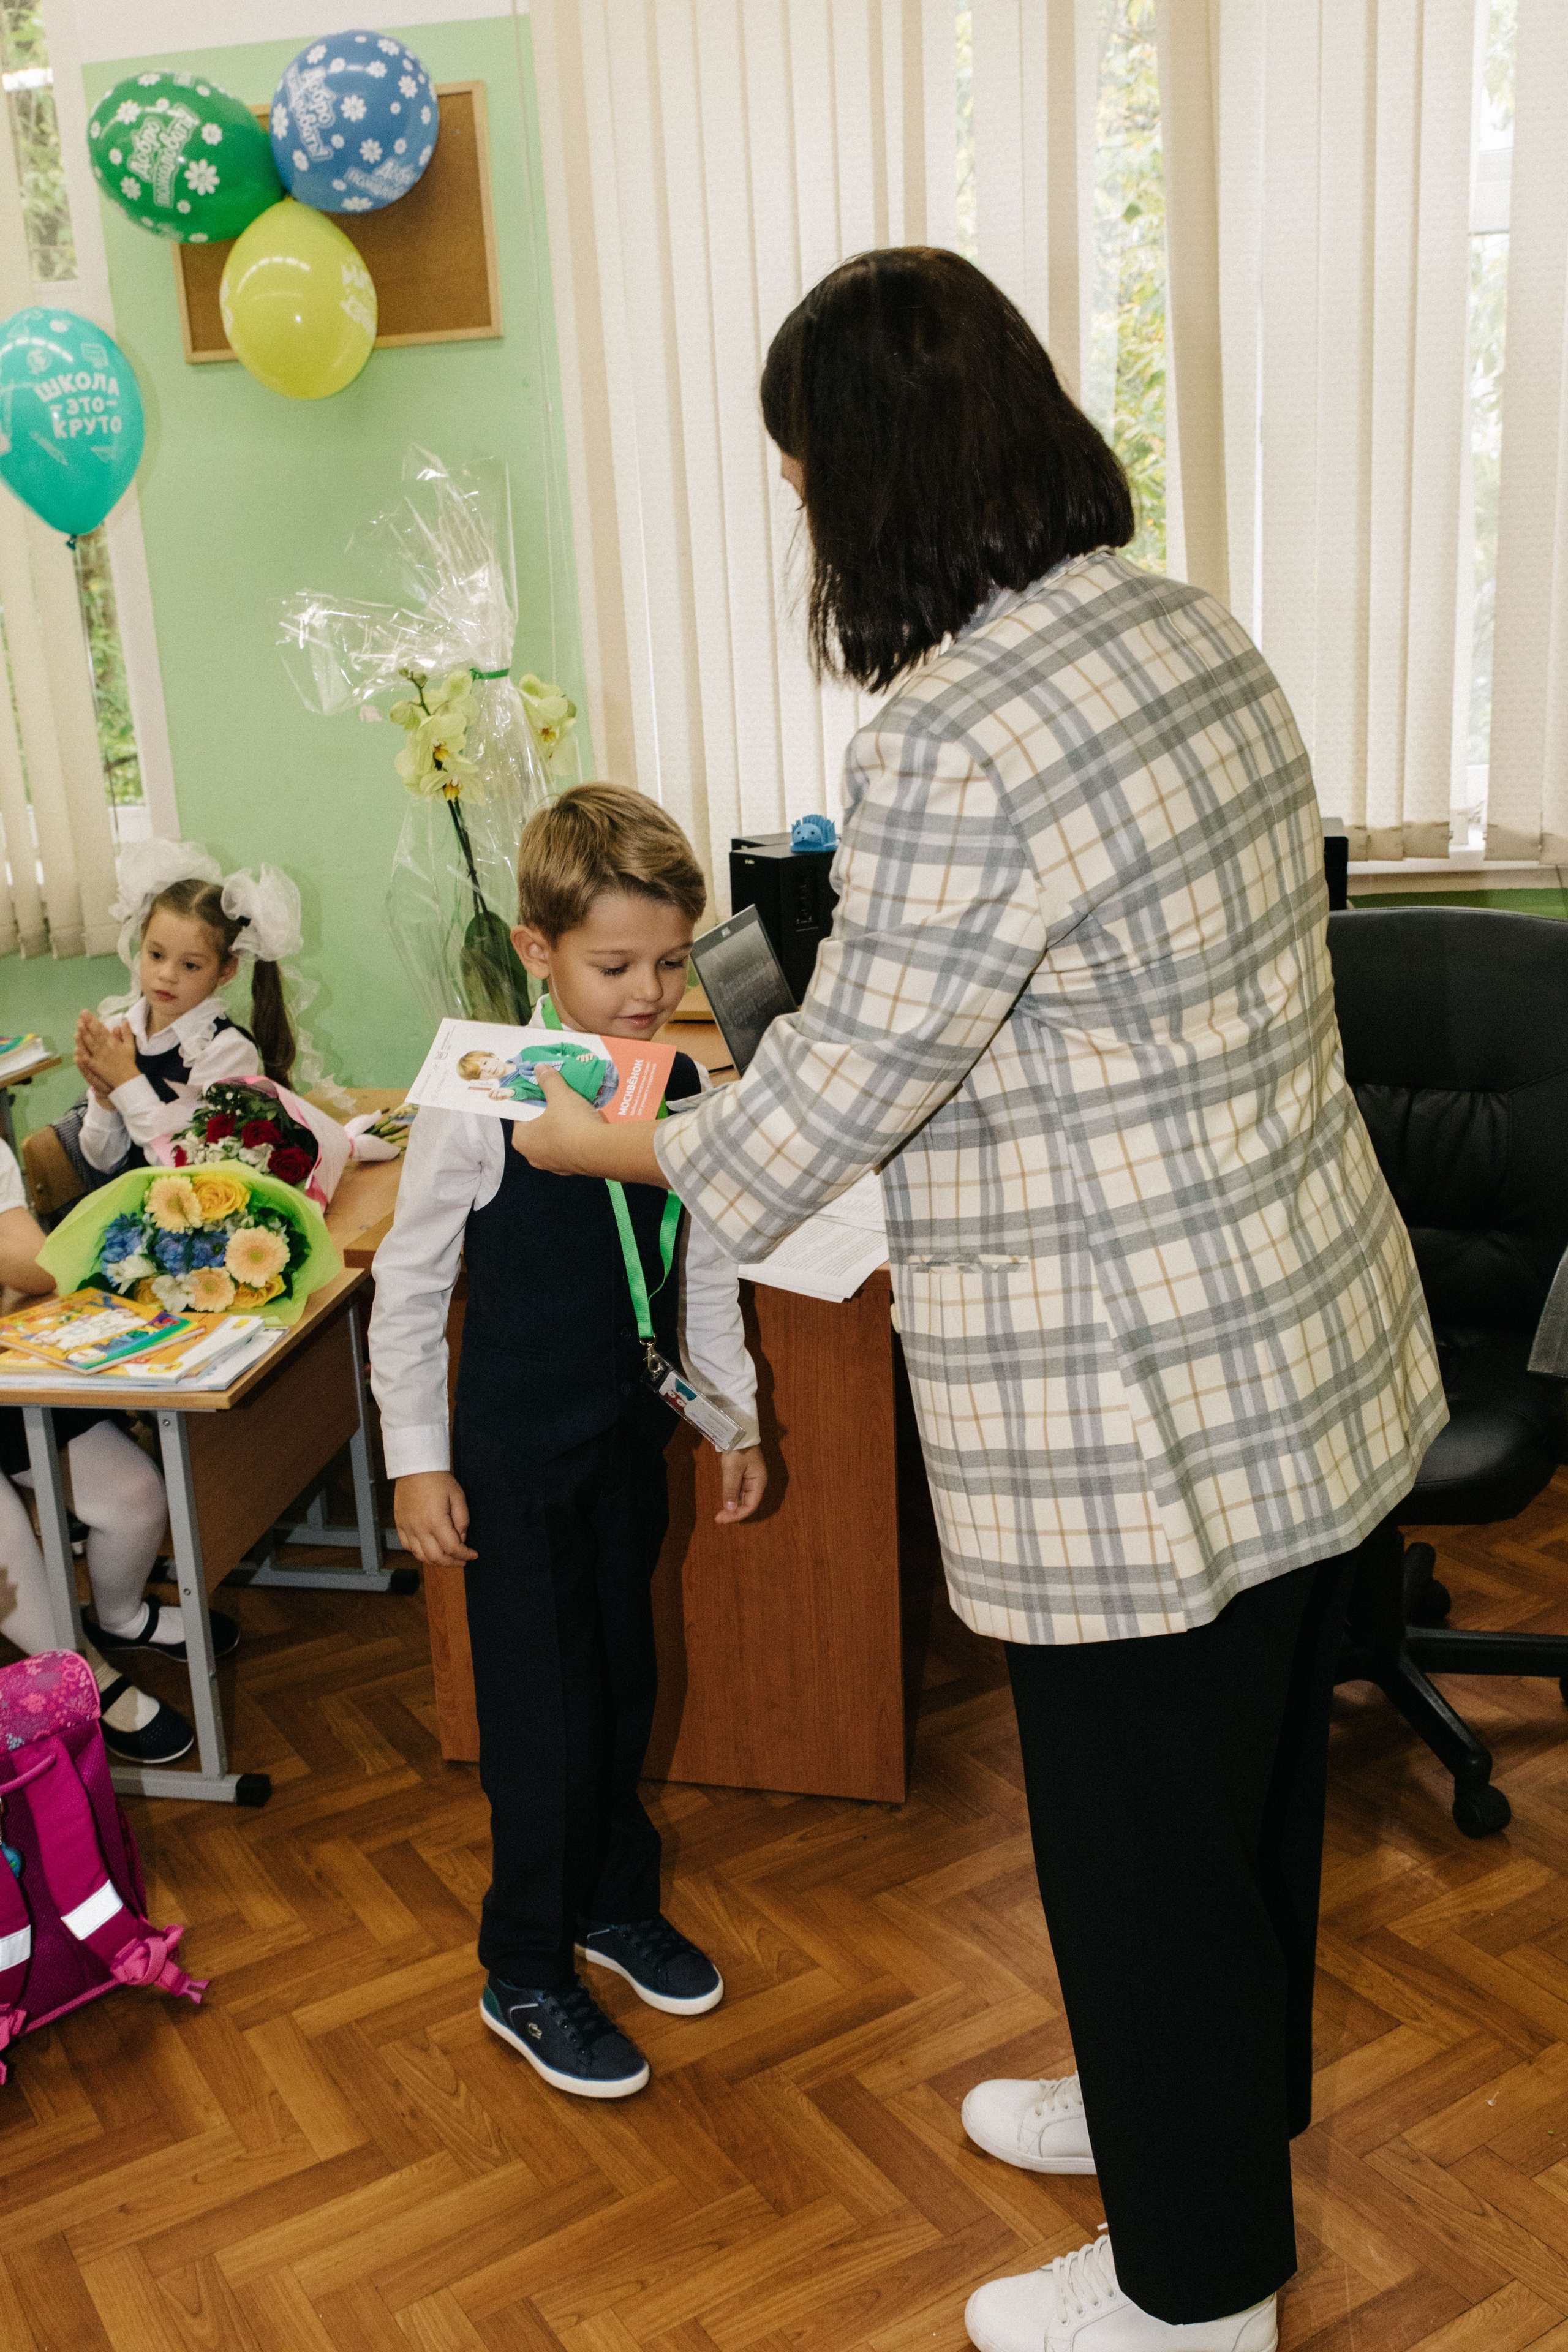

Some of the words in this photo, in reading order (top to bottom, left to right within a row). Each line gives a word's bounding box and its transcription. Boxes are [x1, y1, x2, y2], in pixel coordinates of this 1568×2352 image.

[301, 66, 333, 123] Добро
[130, 121, 160, 179] Добро
[34, 371, 120, 402] ШКОЛА
[53, 415, 122, 438] КРУТО
[618, 1060, 643, 1115] МОСКВЁНОК
